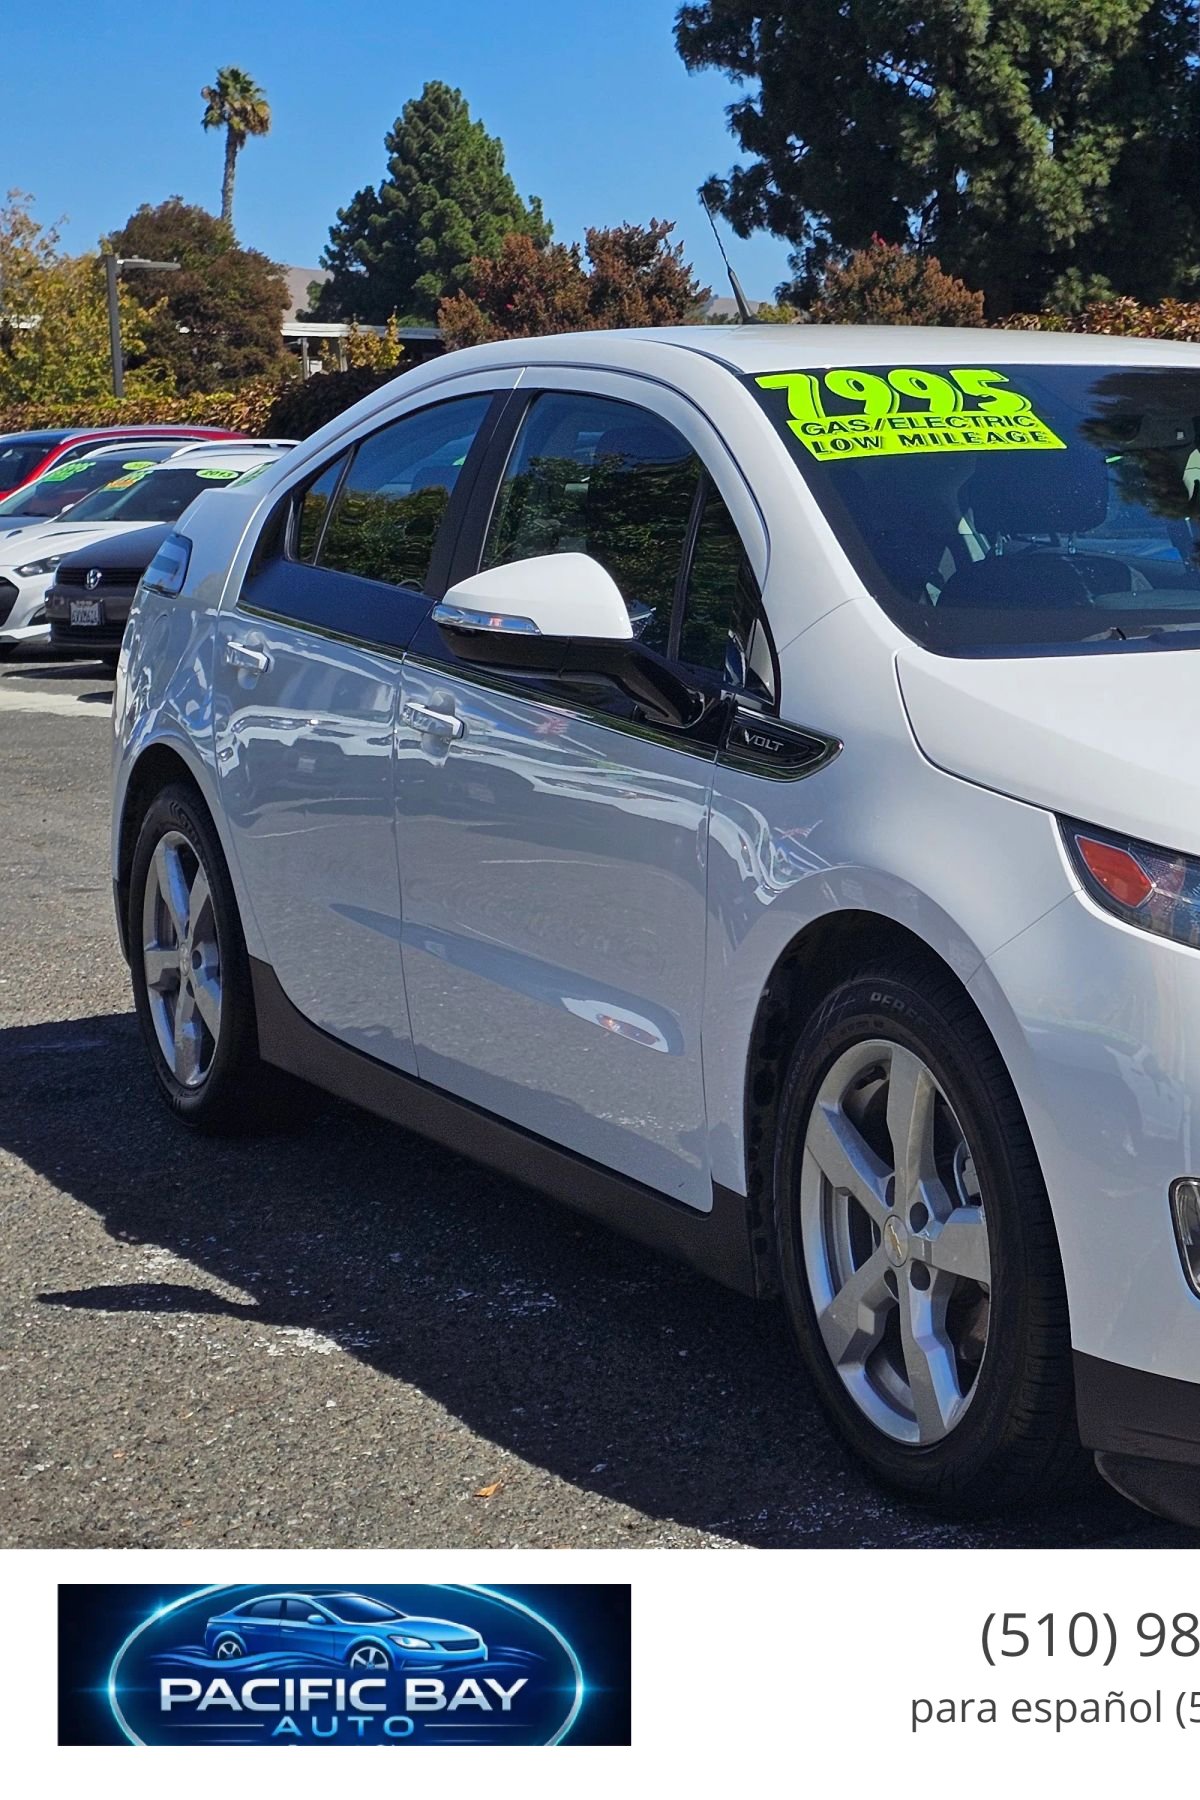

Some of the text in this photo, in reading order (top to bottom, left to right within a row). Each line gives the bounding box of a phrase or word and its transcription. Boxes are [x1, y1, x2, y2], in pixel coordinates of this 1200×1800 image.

[755, 369, 1032, 420] 7995
[800, 415, 1038, 436] GAS/ELECTRIC
[811, 430, 1049, 454] LOW MILEAGE
[743, 728, 784, 751] VOLT
